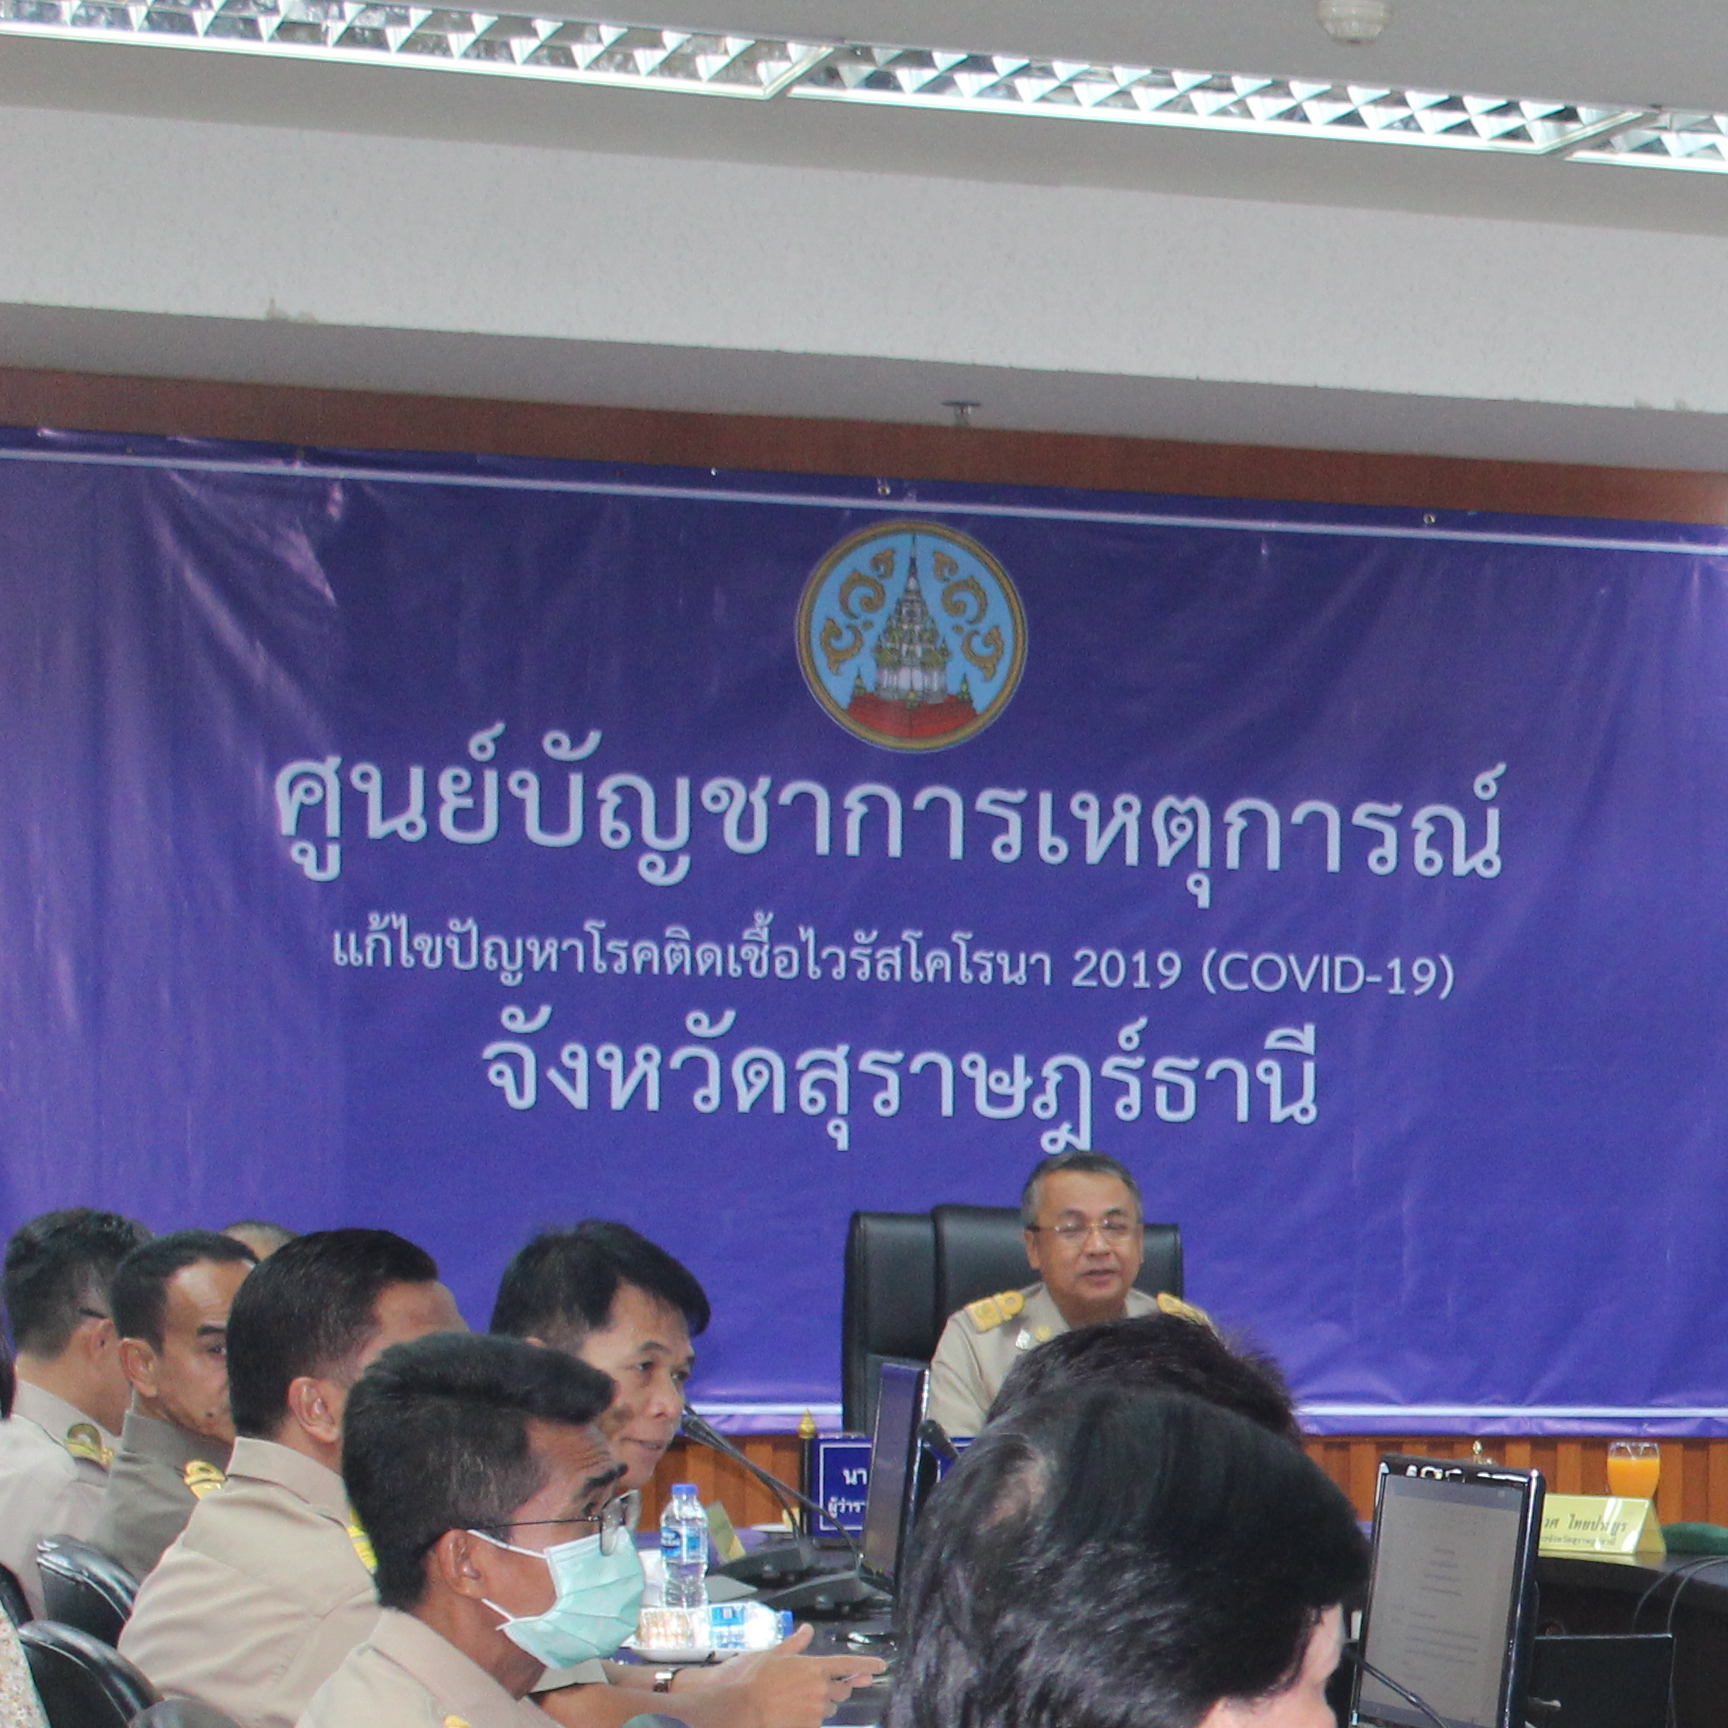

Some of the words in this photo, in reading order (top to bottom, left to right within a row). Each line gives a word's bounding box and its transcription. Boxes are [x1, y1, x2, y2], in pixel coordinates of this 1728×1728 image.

[273, 721, 1505, 908] ศูนย์บัญชาการเหตุการณ์
[332, 910, 1052, 987] แก้ไขปัญหาโรคติดเชื้อไวรัสโคโรนา
[1071, 947, 1183, 991] 2019
[1201, 947, 1455, 1001] (COVID-19)
[481, 1003, 1319, 1154] จังหวัดสุราษฎร์ธานี
